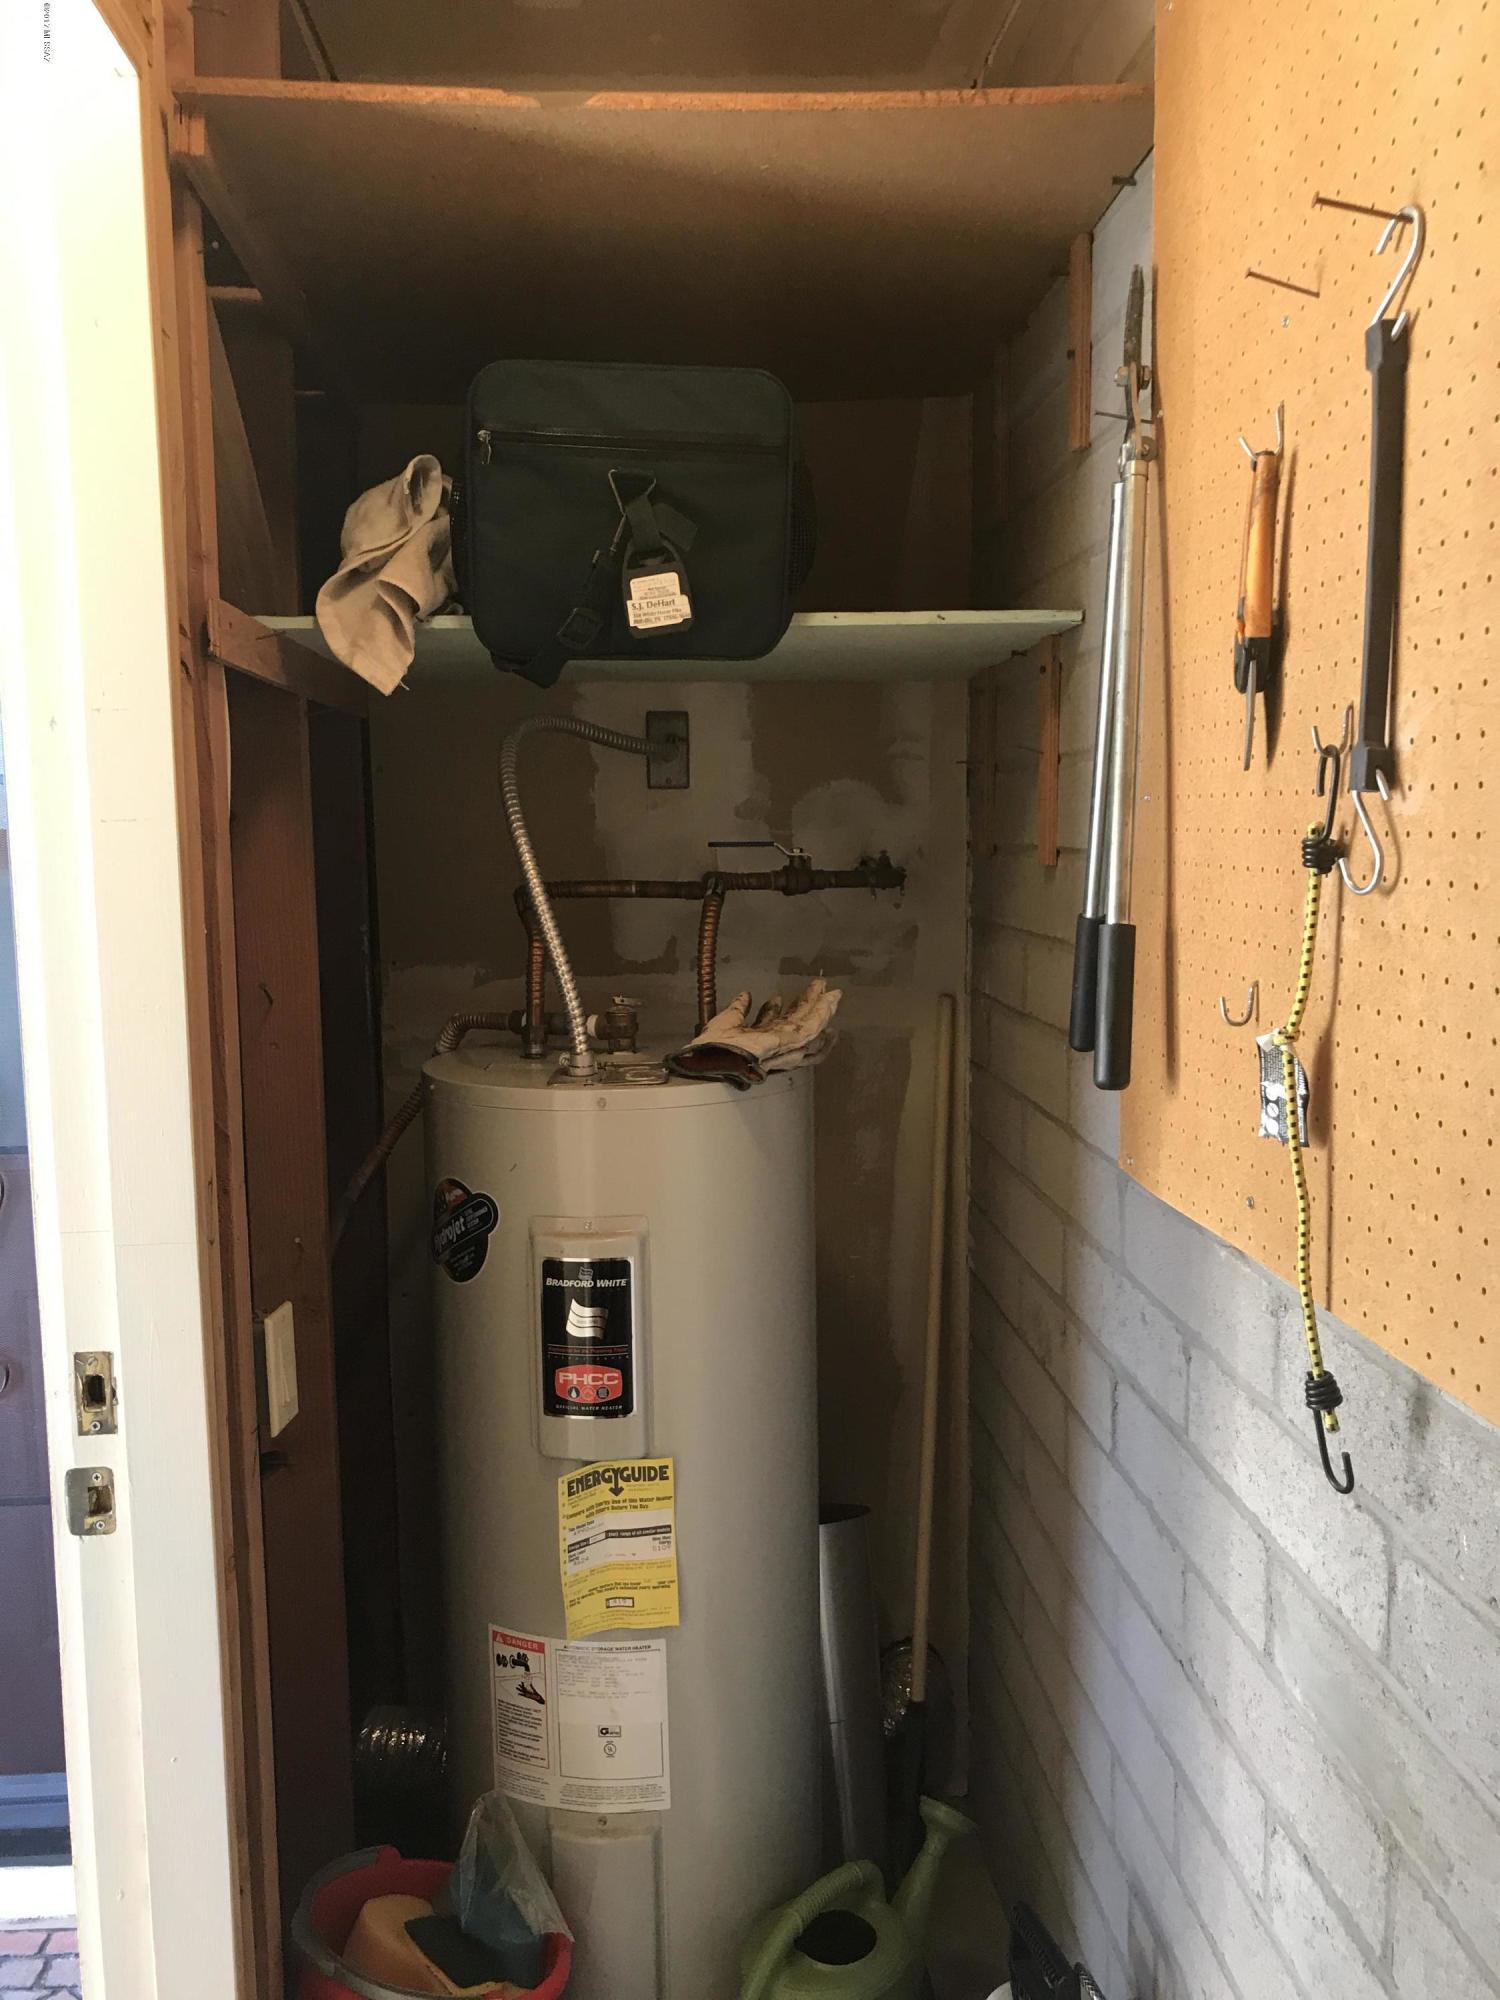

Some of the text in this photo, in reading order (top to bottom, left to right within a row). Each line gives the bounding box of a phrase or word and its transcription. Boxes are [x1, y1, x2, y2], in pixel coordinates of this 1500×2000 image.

[646, 599, 676, 609] DeHart
[545, 1277, 629, 1288] BRADFORD WHITE
[559, 1372, 619, 1386] PHCC
[507, 1636, 538, 1650] DANGER
